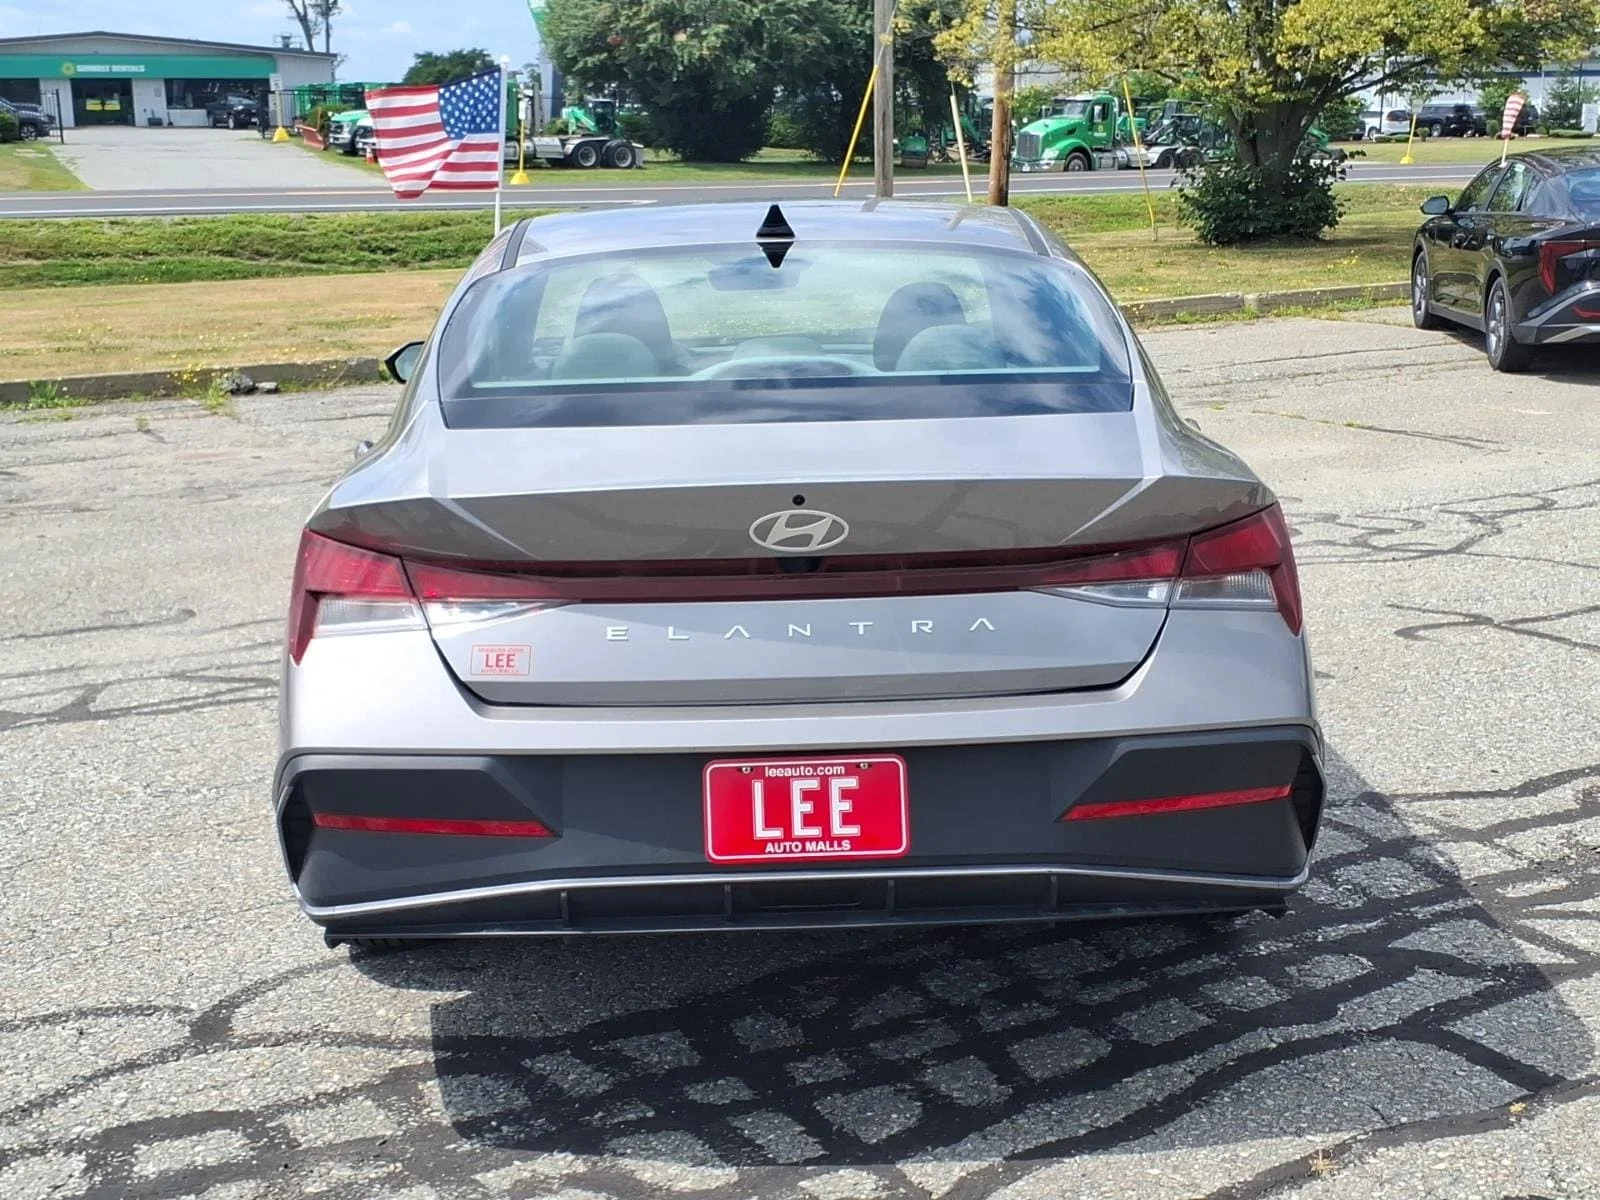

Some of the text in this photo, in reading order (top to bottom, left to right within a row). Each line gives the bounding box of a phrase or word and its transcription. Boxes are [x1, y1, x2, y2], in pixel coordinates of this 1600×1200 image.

[606, 617, 996, 642] ELANTRA
[485, 653, 516, 668] LEE
[764, 764, 845, 778] leeauto.com
[752, 775, 861, 840] LEE
[764, 839, 851, 854] AUTO MALLS
